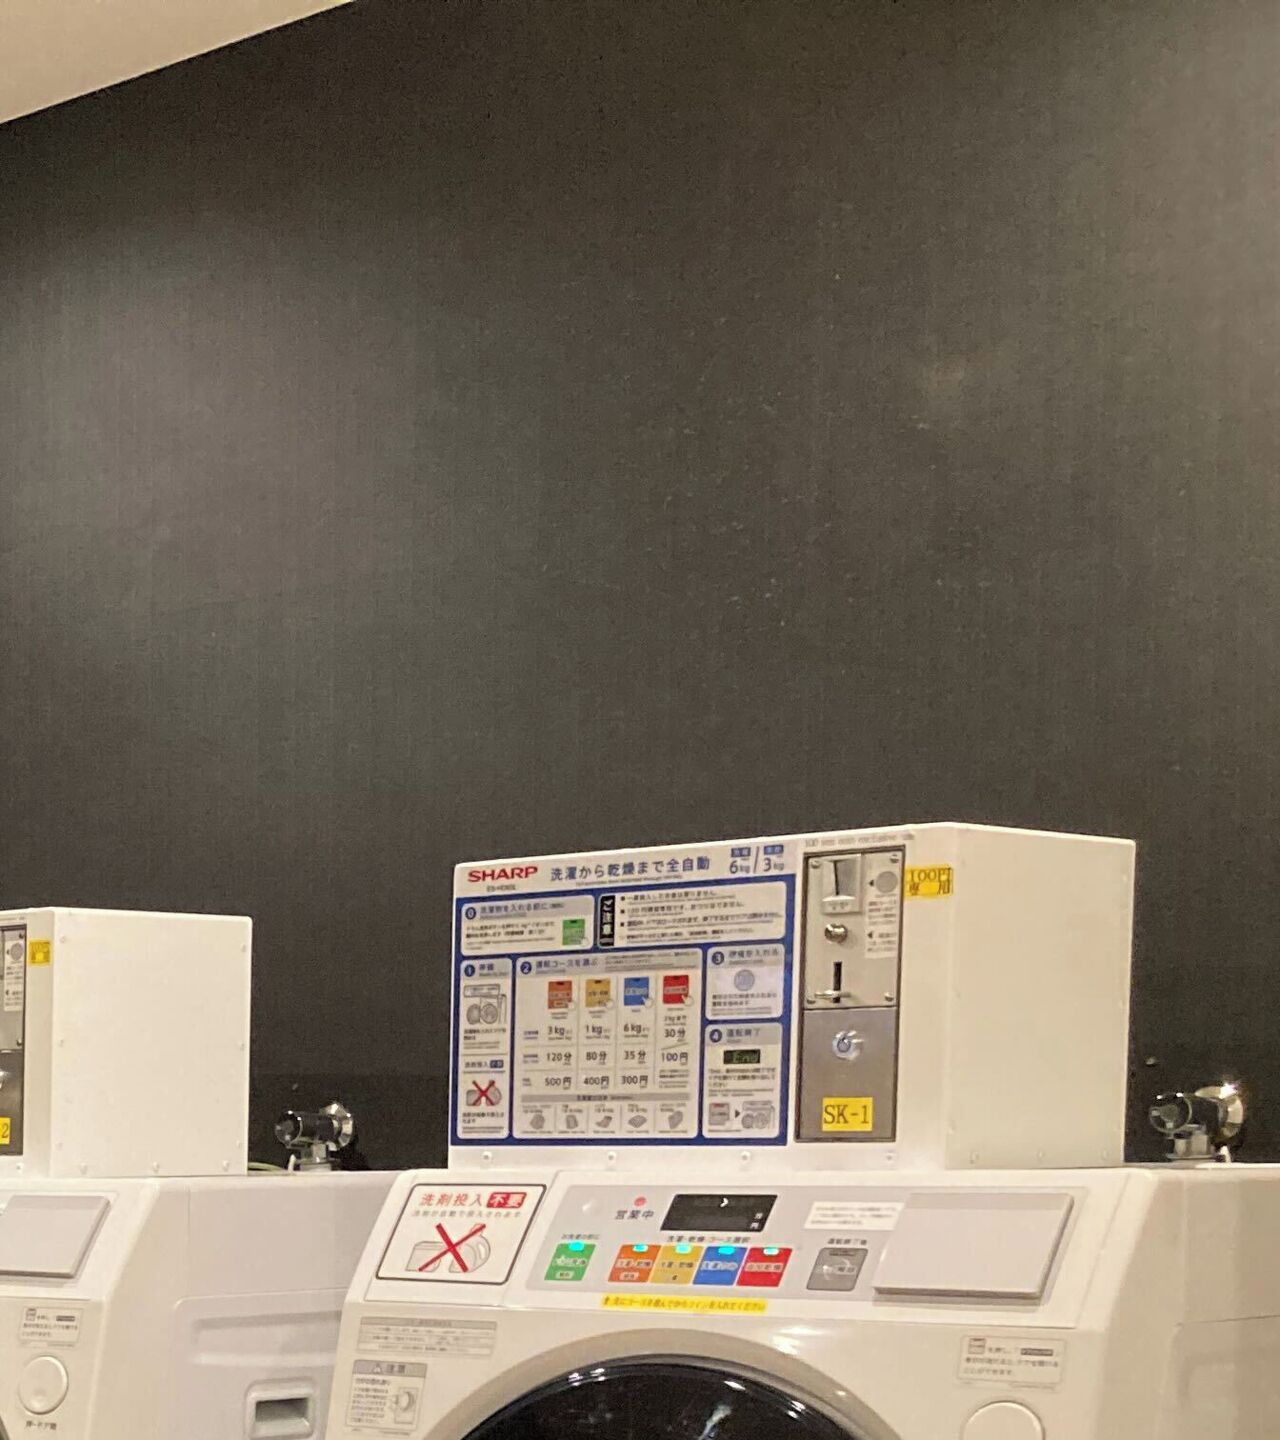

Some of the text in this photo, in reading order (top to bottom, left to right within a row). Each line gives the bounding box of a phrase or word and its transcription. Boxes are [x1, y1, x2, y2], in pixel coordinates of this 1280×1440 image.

[468, 866, 538, 882] SHARP
[551, 855, 710, 881] 洗濯から乾燥まで全自動
[823, 1104, 870, 1124] SK-1
[419, 1192, 483, 1208] 洗剤投入
[614, 1209, 654, 1220] 営業中
